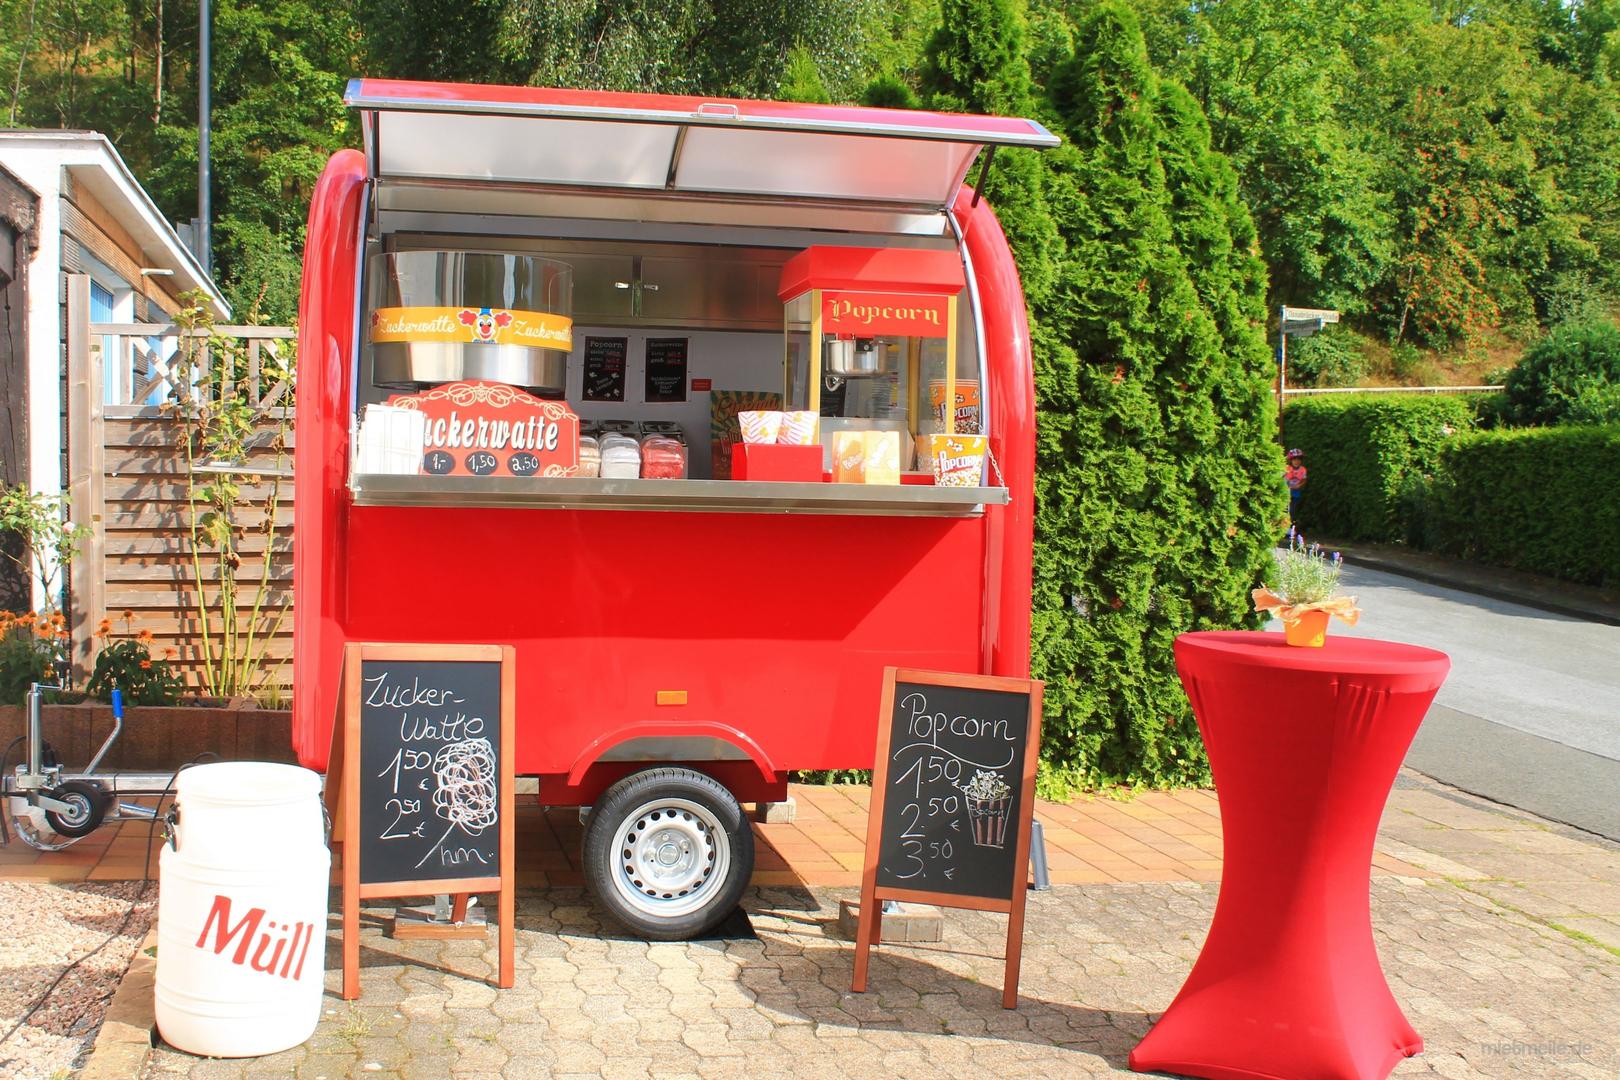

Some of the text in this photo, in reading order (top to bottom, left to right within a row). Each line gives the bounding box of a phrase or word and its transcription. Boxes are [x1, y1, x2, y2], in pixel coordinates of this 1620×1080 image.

[380, 314, 457, 334] Zuckerwatte
[828, 299, 941, 325] Popcorn
[423, 411, 559, 450] uckerwatte
[364, 672, 465, 708] Zucker-
[400, 712, 488, 742] Watte
[901, 692, 1017, 750] Popcorn
[195, 895, 315, 982] Müll
